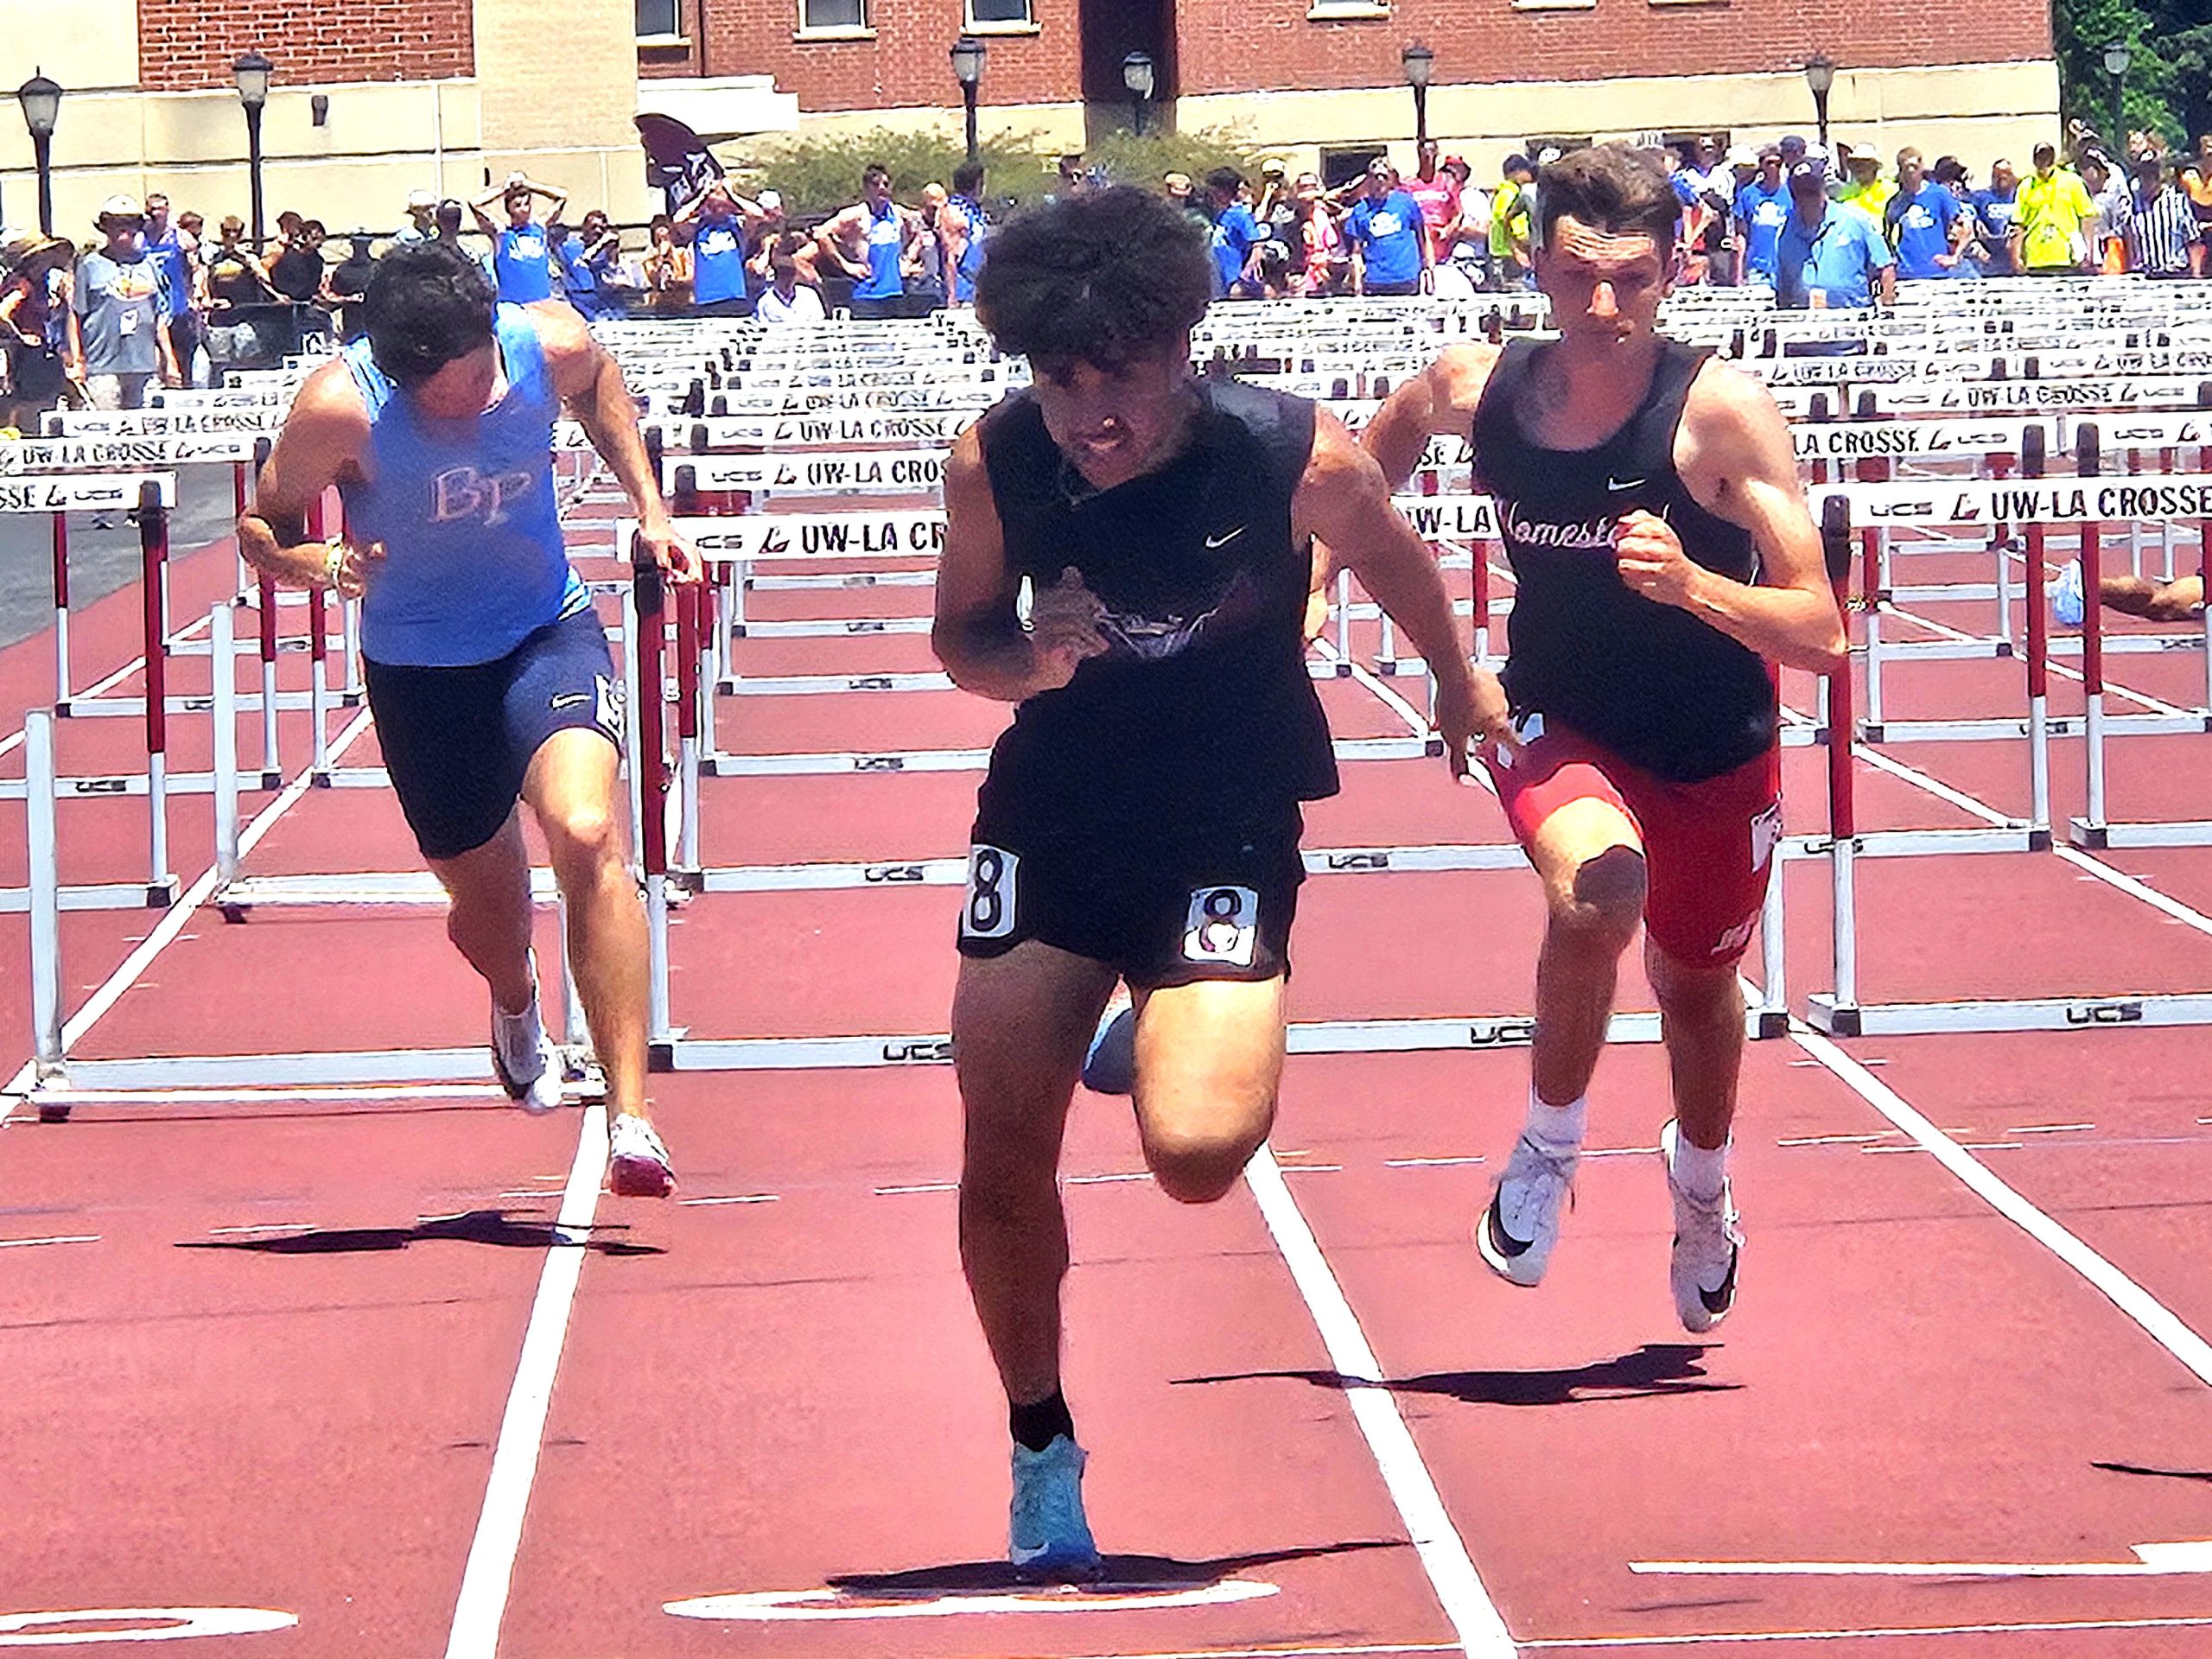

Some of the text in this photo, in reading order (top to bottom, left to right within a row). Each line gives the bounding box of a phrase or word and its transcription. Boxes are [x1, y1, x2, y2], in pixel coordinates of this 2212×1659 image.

[1828, 427, 1922, 454] CROSSE
[808, 461, 882, 486] UW-LA
[1991, 490, 2088, 521] UW-LA
[2098, 484, 2212, 518] CROSSE
[801, 521, 898, 553] UW-LA
[970, 849, 1003, 932] 8
[1198, 889, 1242, 953] 8
[2066, 1002, 2143, 1024] UCS
